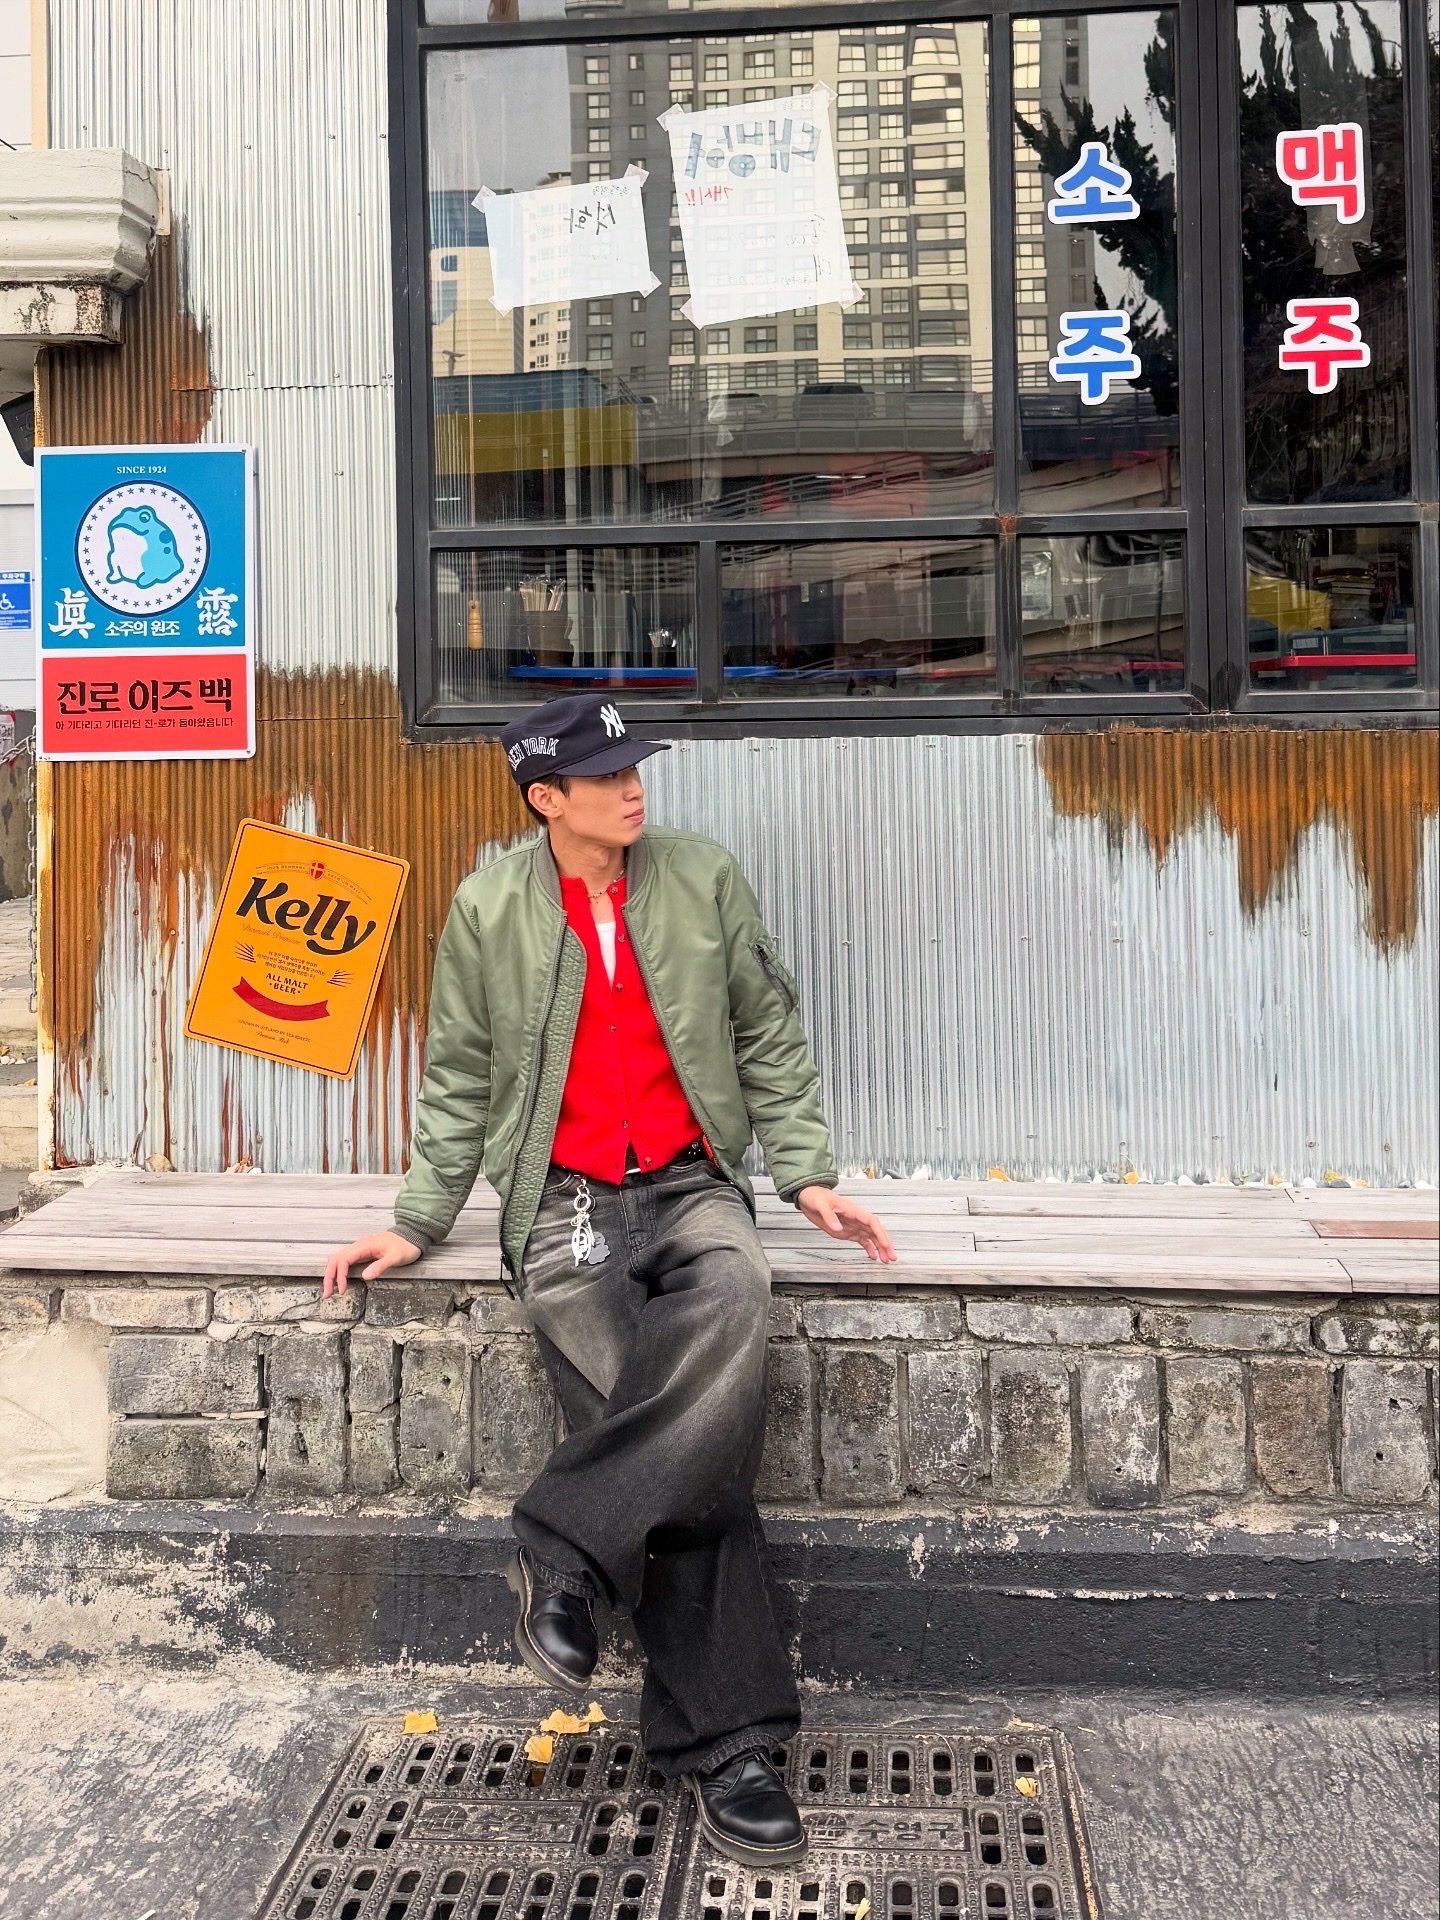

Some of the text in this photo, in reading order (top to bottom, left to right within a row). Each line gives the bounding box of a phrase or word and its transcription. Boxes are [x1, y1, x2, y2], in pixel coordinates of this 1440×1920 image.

[1278, 124, 1370, 393] 맥주
[1050, 143, 1140, 404] 소주
[117, 466, 167, 474] SINCE 1924
[48, 587, 96, 639] 眞
[197, 587, 238, 636] 露
[105, 620, 180, 637] 소주의 원조
[57, 680, 121, 715] 진로
[199, 678, 232, 713] 백
[56, 721, 64, 730] 아
[68, 721, 102, 729] 기다리고
[106, 720, 141, 729] 기다리던
[600, 704, 626, 738] NY
[521, 737, 559, 756] YORK
[236, 876, 376, 955] Kelly
[266, 973, 308, 989] ALL MALT
[274, 983, 297, 995] BEER
[857, 1819, 960, 1840] 수영구
